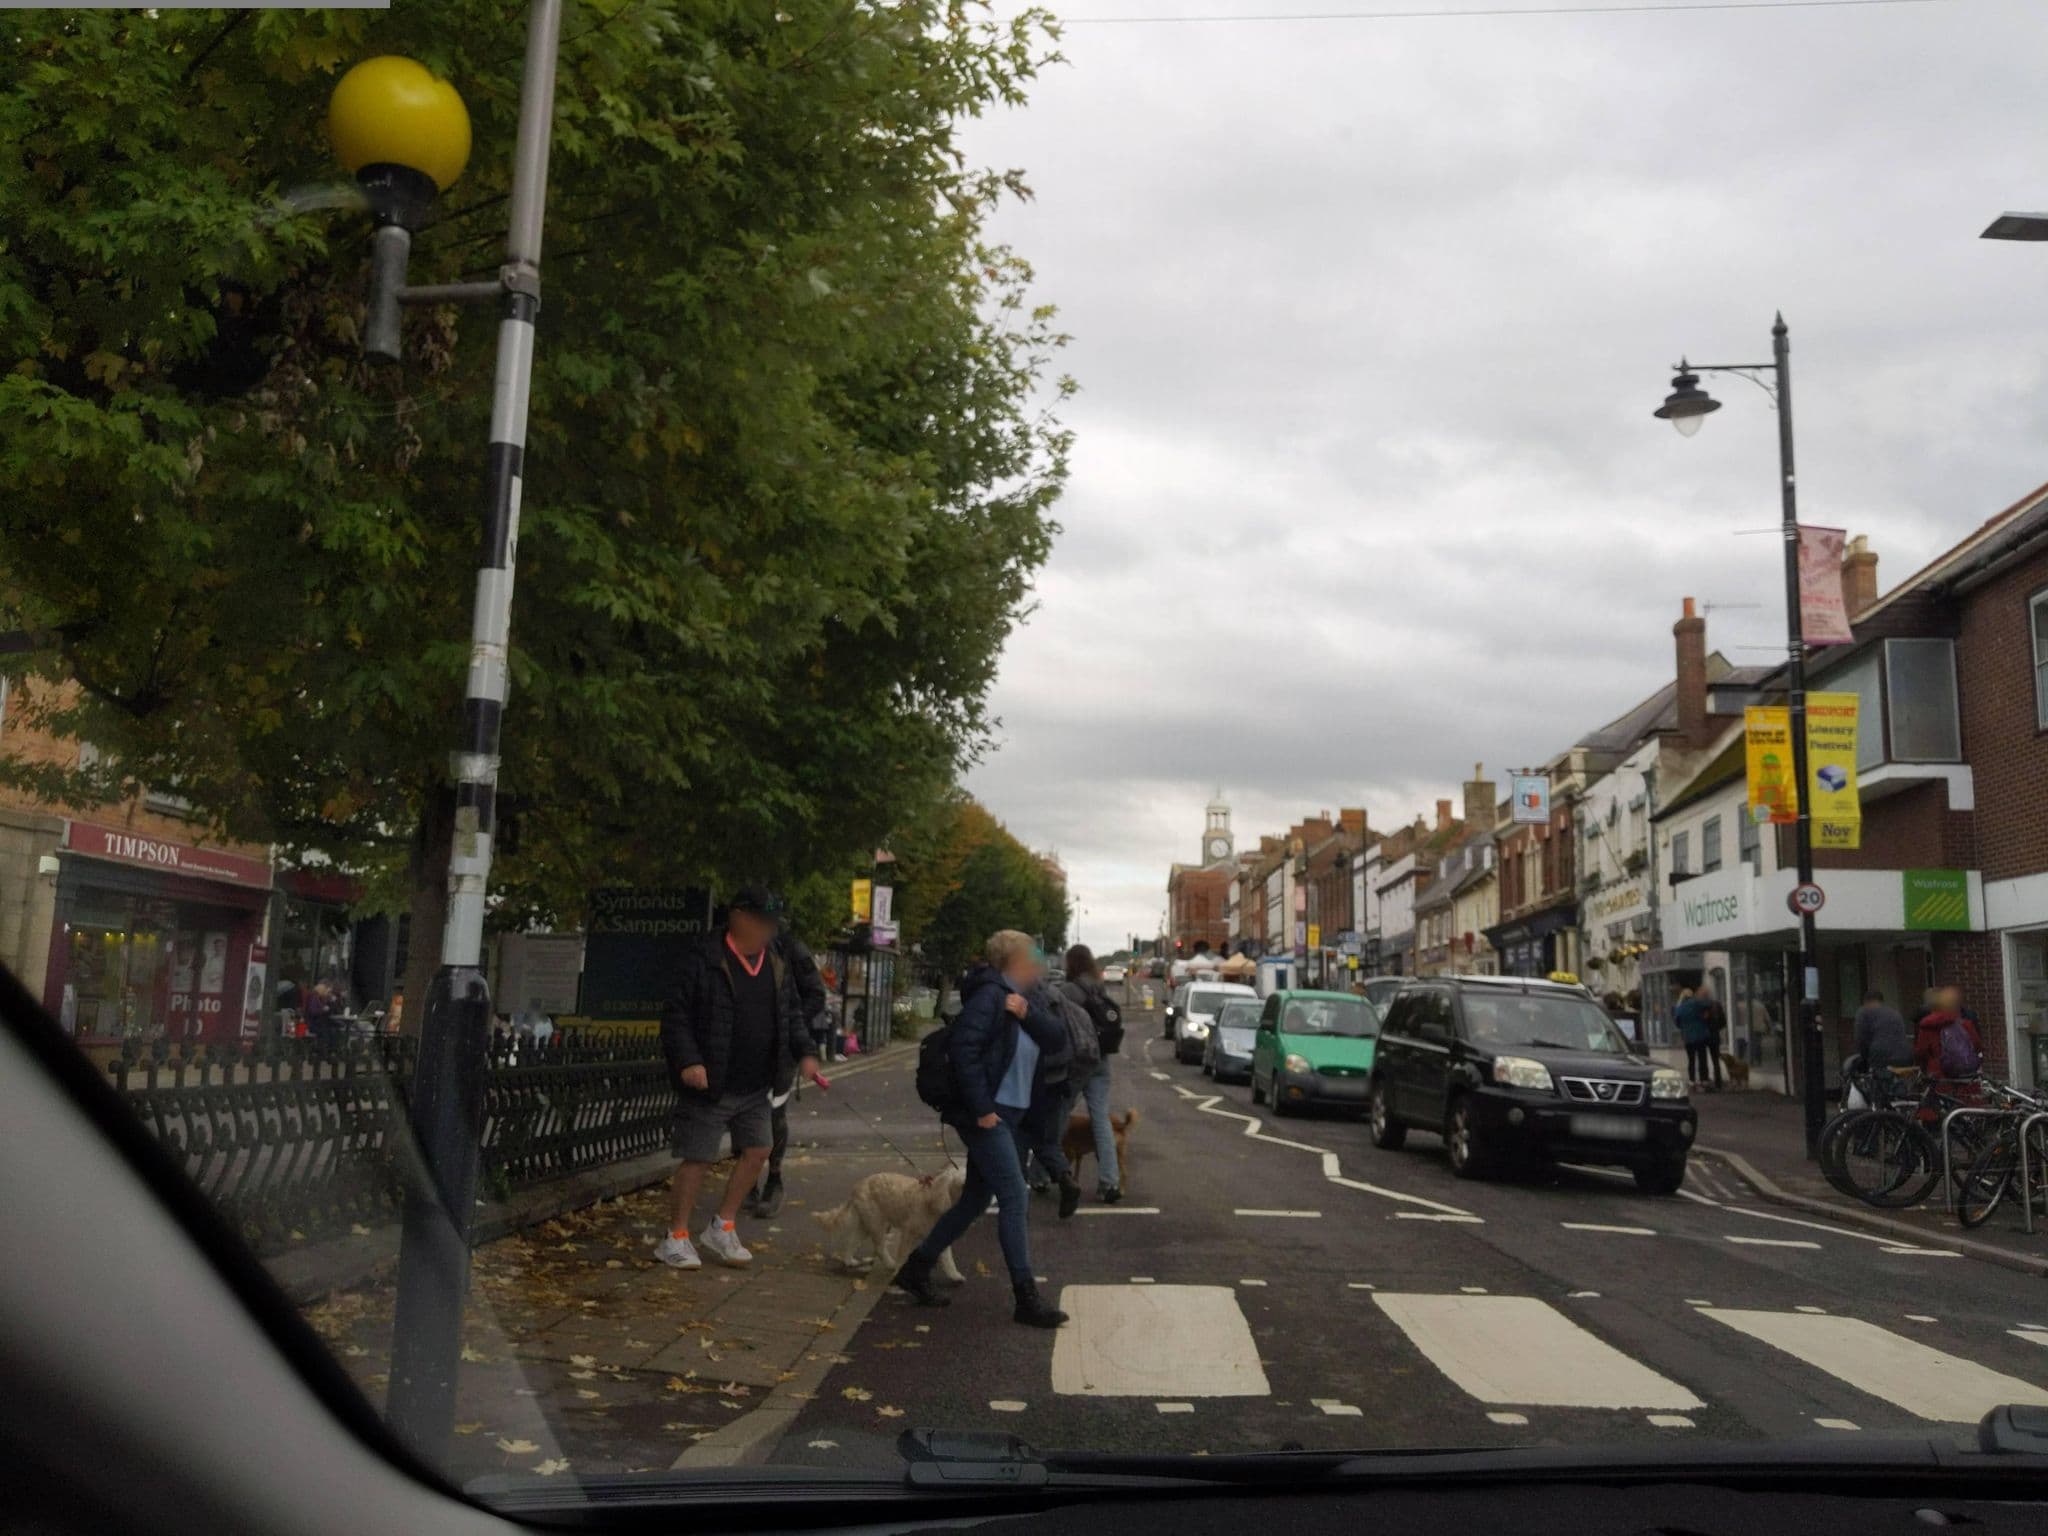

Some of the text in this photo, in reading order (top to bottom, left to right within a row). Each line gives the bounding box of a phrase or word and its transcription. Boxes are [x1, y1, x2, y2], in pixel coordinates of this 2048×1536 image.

[1821, 823, 1851, 837] Nov
[104, 832, 180, 866] TIMPSON
[1912, 879, 1959, 889] Waitrose
[1799, 891, 1820, 903] 20
[1684, 893, 1738, 928] Waitrose
[611, 915, 701, 935] Sampson
